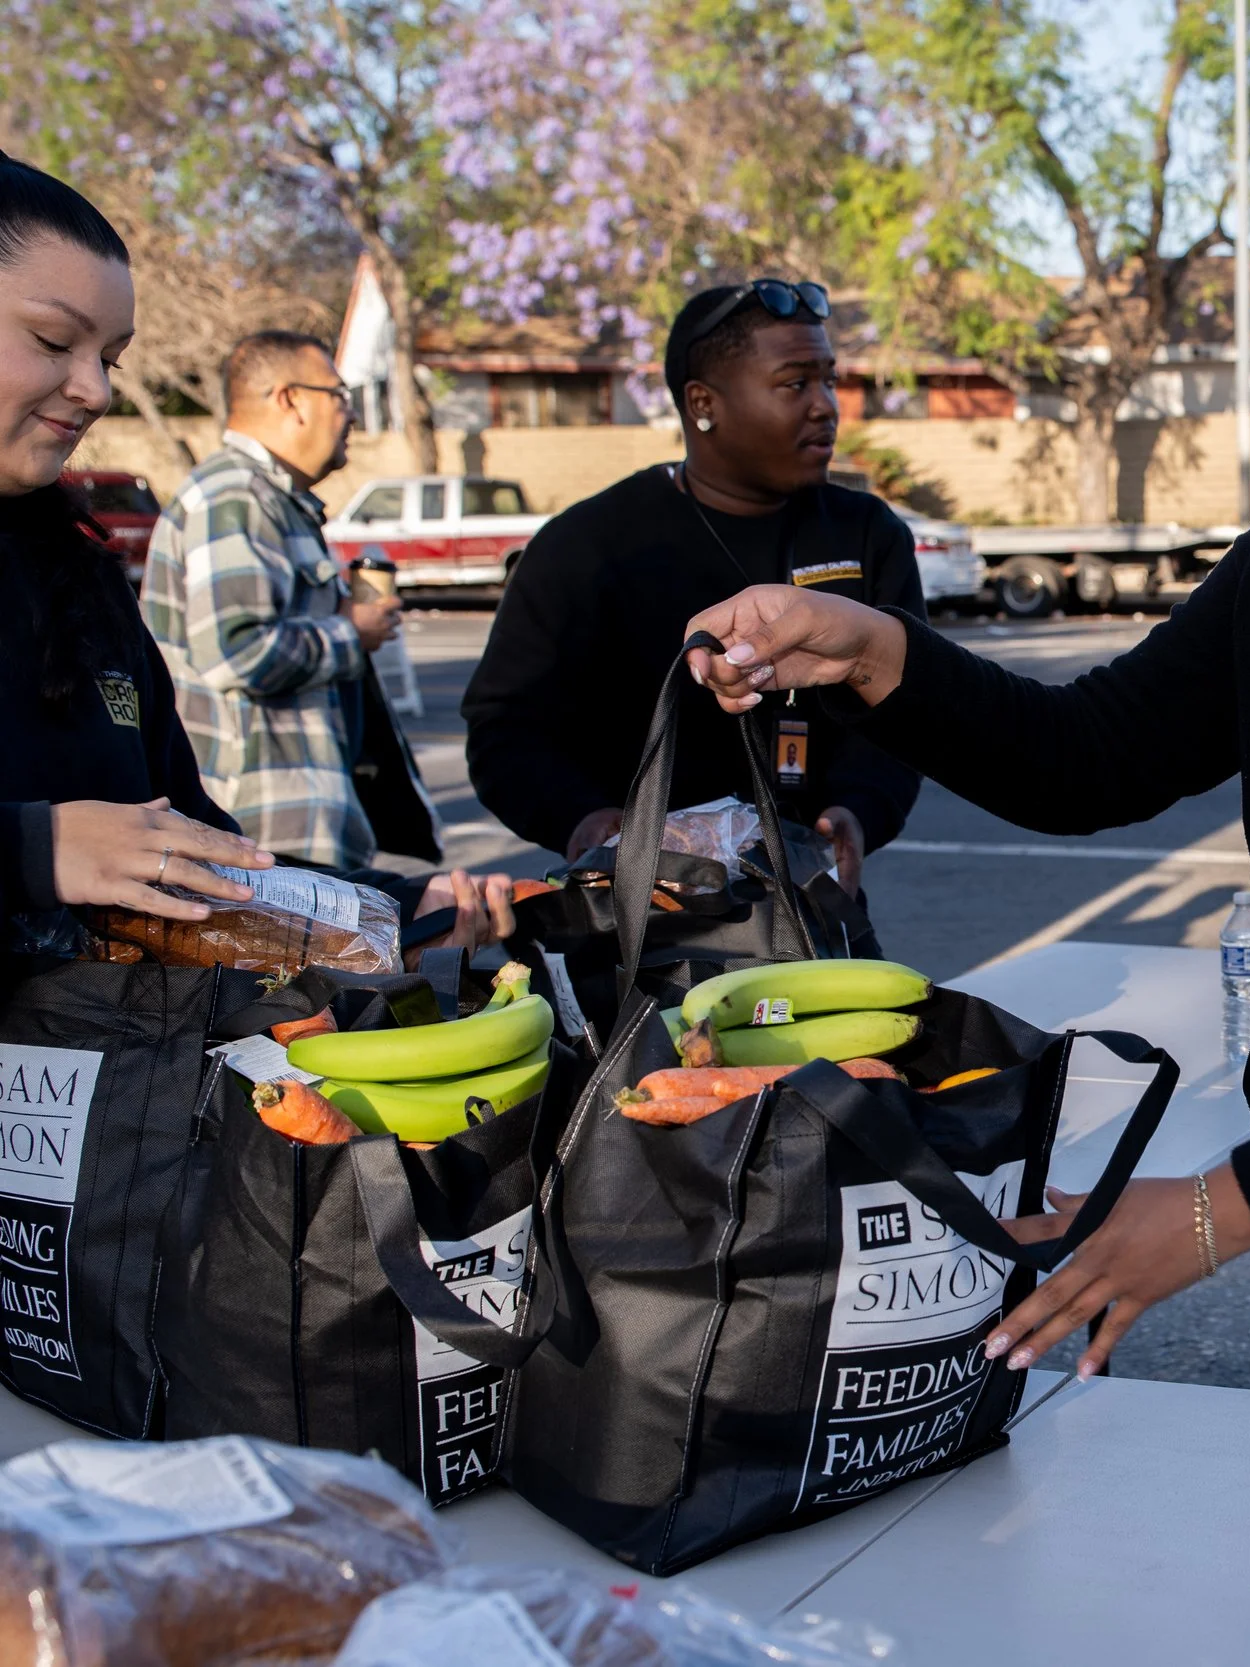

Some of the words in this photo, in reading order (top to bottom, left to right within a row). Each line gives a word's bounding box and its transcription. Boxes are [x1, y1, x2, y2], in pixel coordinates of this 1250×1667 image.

[109, 702, 136, 722] RO
[0, 1063, 79, 1106] AM
[0, 1121, 70, 1167] ON
[861, 1212, 906, 1243] THE
[437, 1256, 489, 1281] THE
[853, 1250, 1008, 1312] SIMON
[4, 1327, 72, 1363] NDATION
[821, 1397, 971, 1477] FAMILIES
